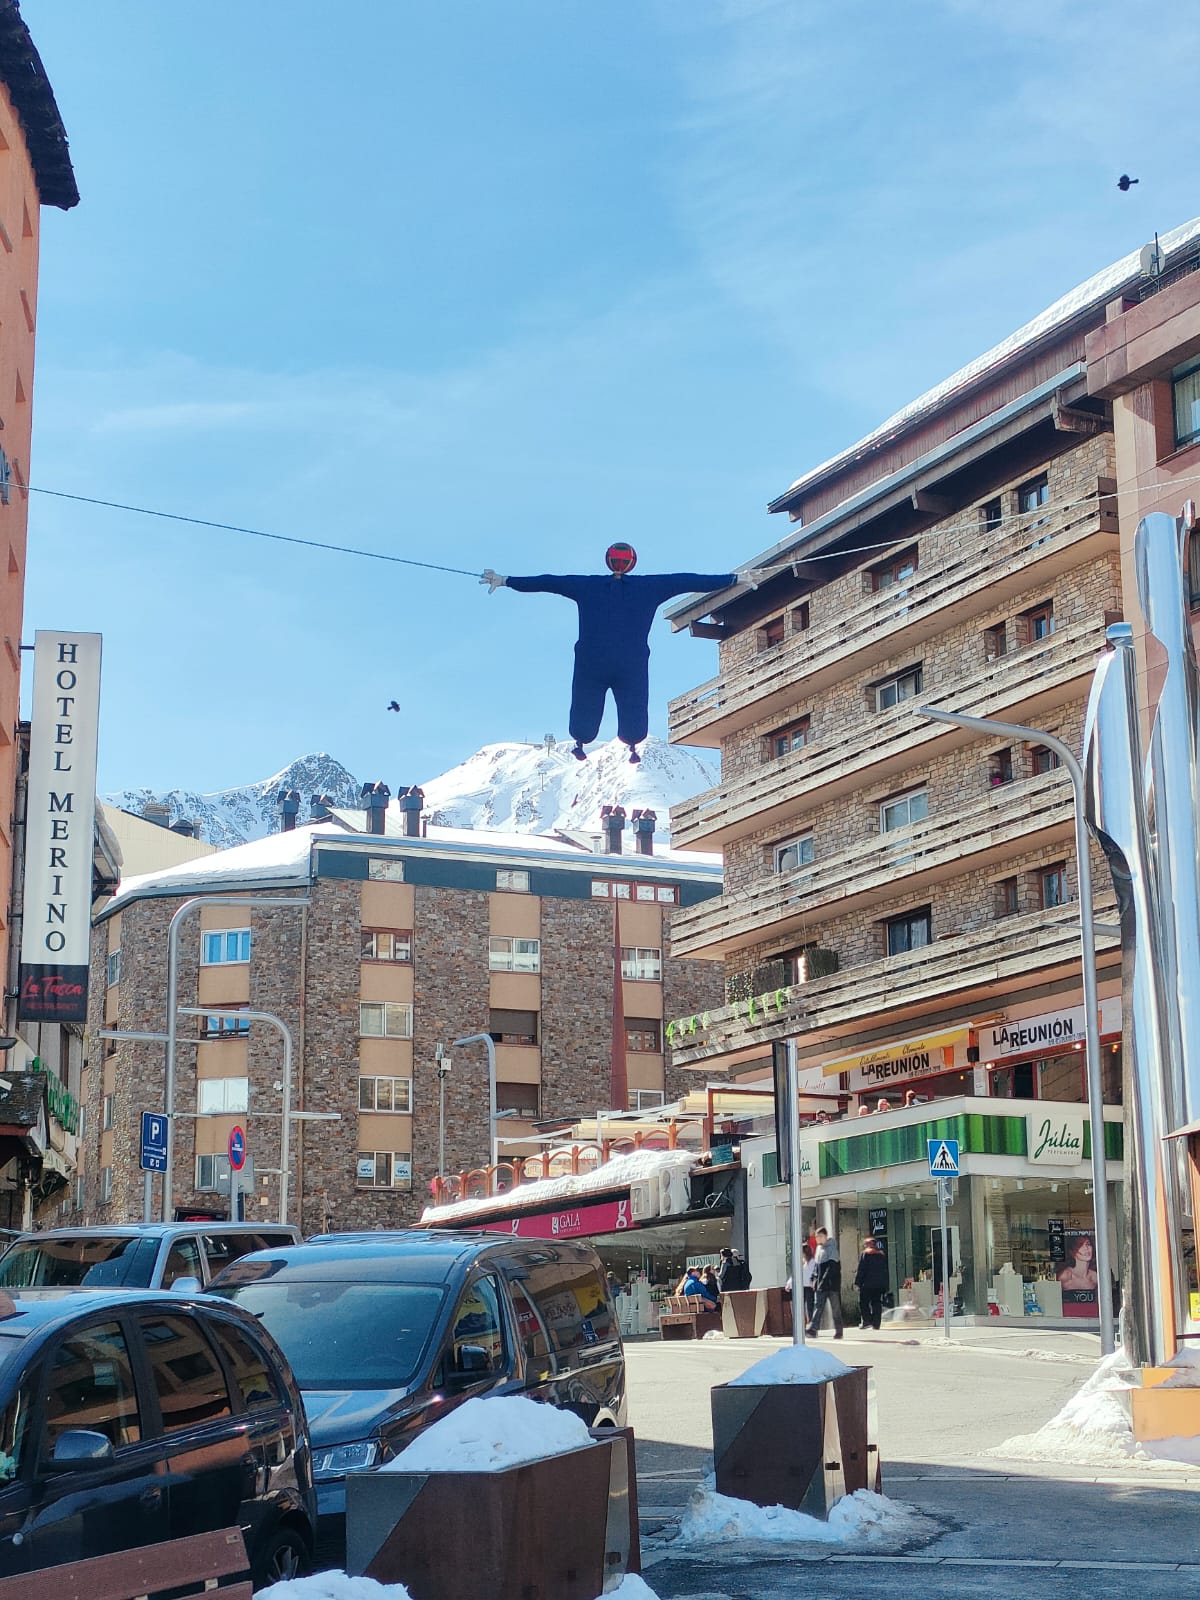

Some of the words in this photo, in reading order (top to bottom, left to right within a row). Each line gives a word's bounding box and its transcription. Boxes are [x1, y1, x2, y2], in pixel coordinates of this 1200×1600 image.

[52, 643, 79, 772] HOTEL
[45, 791, 75, 953] MERINO
[992, 1028, 1010, 1046] LA
[1009, 1018, 1074, 1049] REUNIÓN
[861, 1063, 877, 1076] LA
[151, 1122, 160, 1140] P
[1034, 1119, 1080, 1159] Júlia
[559, 1213, 581, 1227] GALA
[1074, 1293, 1095, 1303] YOU
